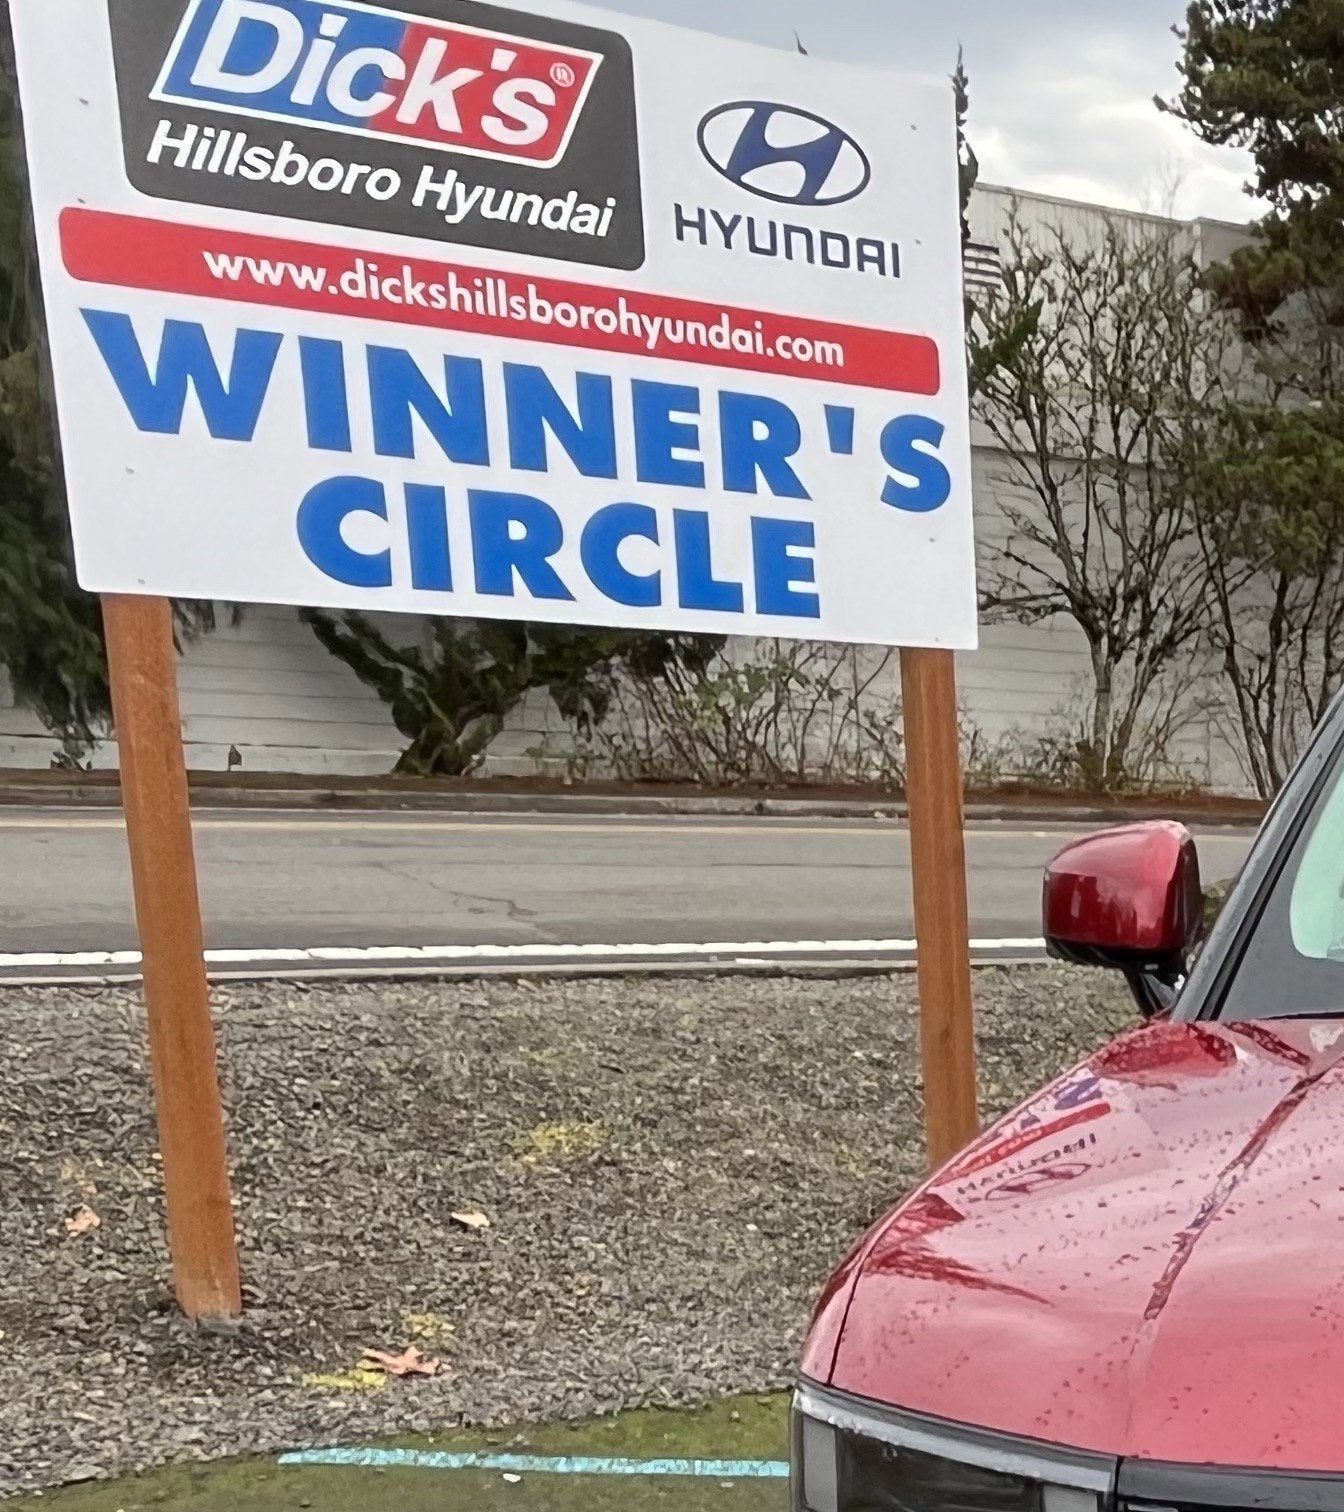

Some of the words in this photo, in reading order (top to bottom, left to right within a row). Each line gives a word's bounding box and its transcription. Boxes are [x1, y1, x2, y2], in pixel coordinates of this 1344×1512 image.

[146, 119, 401, 201] Hillsboro
[412, 165, 616, 237] Hyundai
[674, 203, 902, 278] HYUNDAI
[202, 248, 845, 369] www.dickshillsborohyundai.com
[79, 307, 951, 513] WINNER'S
[296, 475, 821, 618] CIRCLE
